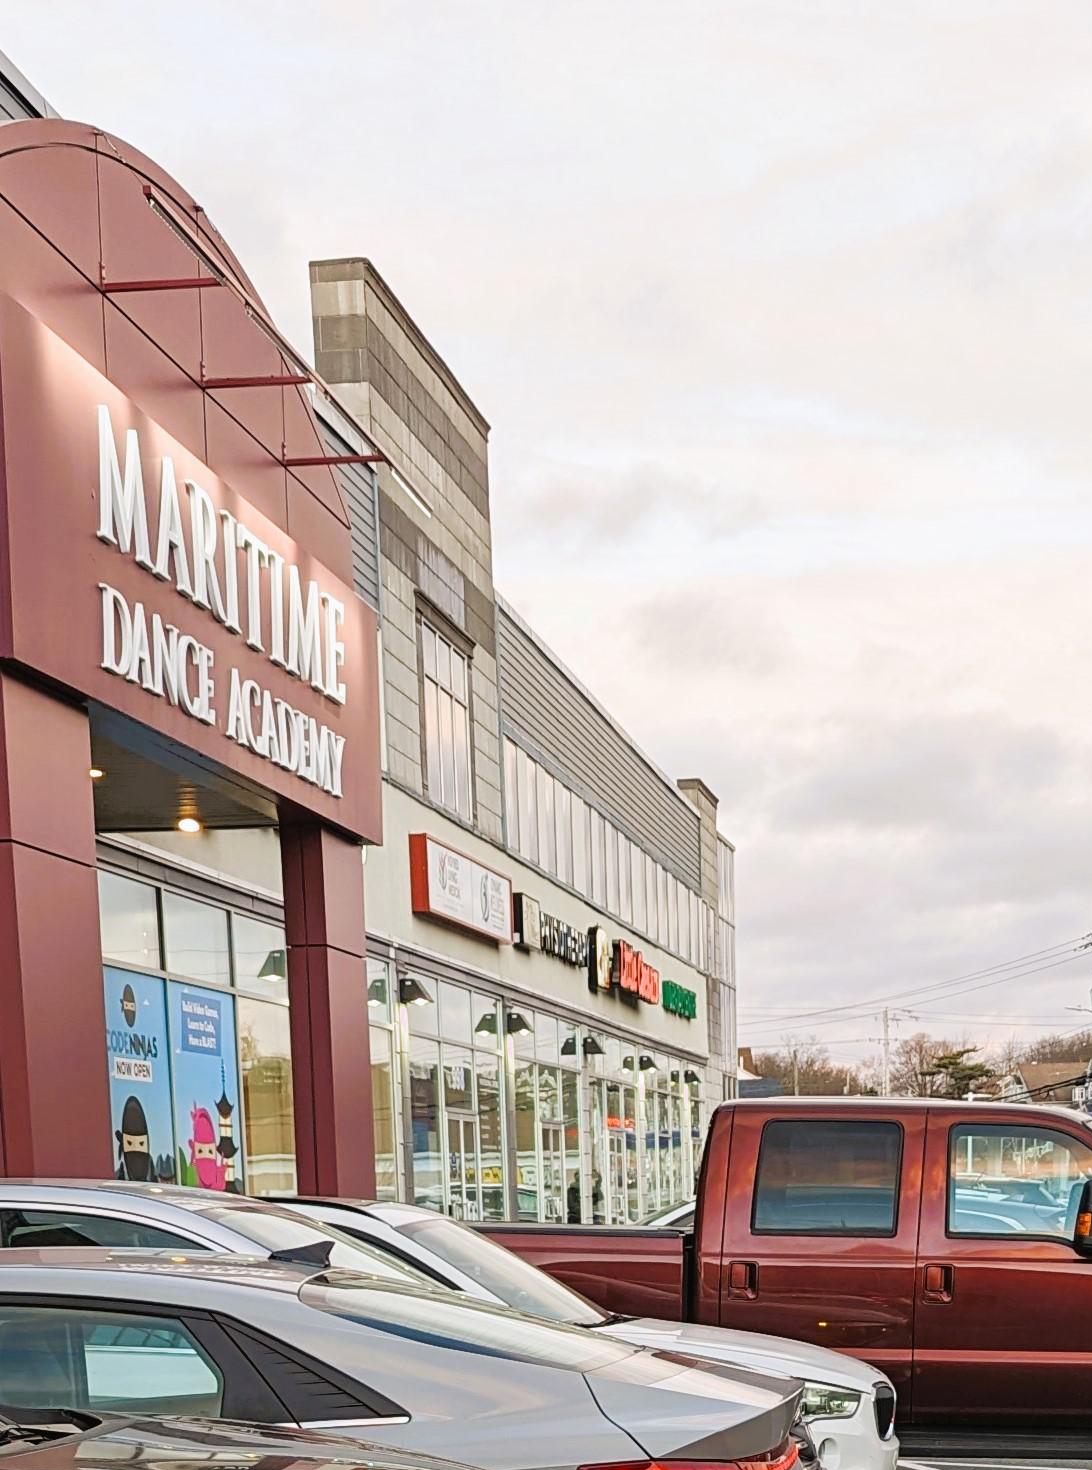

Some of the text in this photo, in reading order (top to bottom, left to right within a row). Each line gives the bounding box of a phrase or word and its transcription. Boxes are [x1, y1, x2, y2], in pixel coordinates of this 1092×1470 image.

[97, 404, 346, 705] MARITIME
[98, 582, 346, 798] DANCE ACADEMY
[116, 1061, 151, 1078] NOW OPEN
